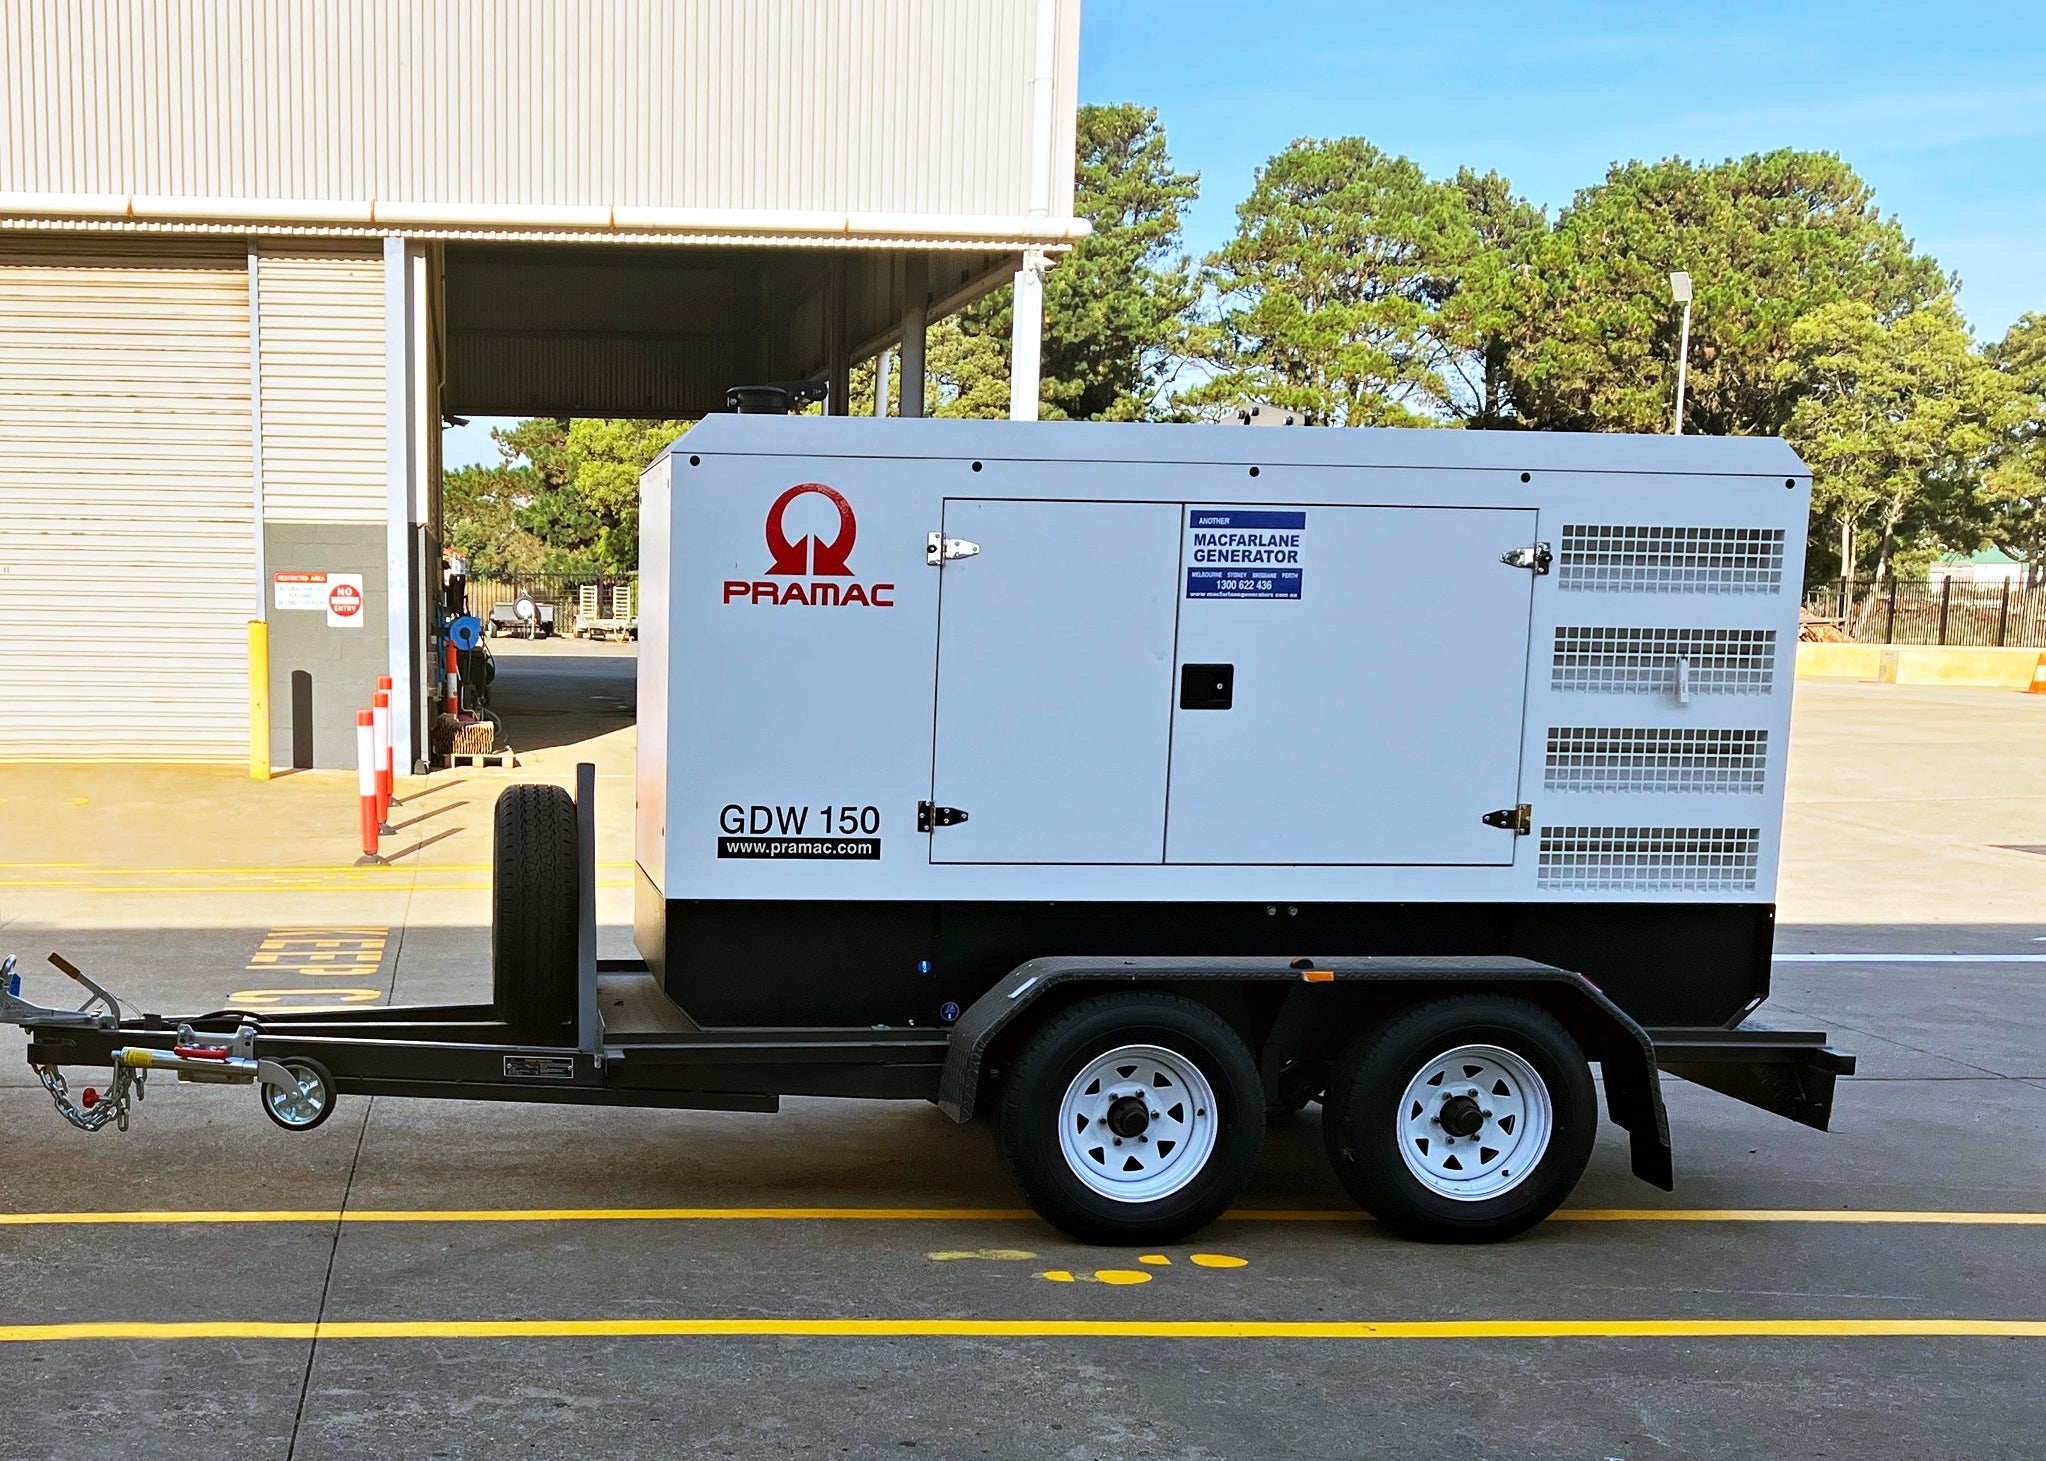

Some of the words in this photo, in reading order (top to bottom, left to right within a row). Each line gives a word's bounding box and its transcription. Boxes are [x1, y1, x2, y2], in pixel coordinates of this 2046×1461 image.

[1198, 517, 1231, 525] ANOTHER
[1193, 533, 1300, 547] MACFARLANE
[1193, 549, 1299, 563] GENERATOR
[1191, 571, 1223, 579] MELBOURNE
[337, 587, 353, 596] NO
[1216, 579, 1237, 590] 1300
[1238, 579, 1255, 590] 622
[1256, 580, 1273, 591] 436
[723, 581, 895, 607] PRAMAC
[719, 804, 809, 835] GDW
[820, 805, 880, 835] 150
[726, 842, 873, 857] www.pramac.com
